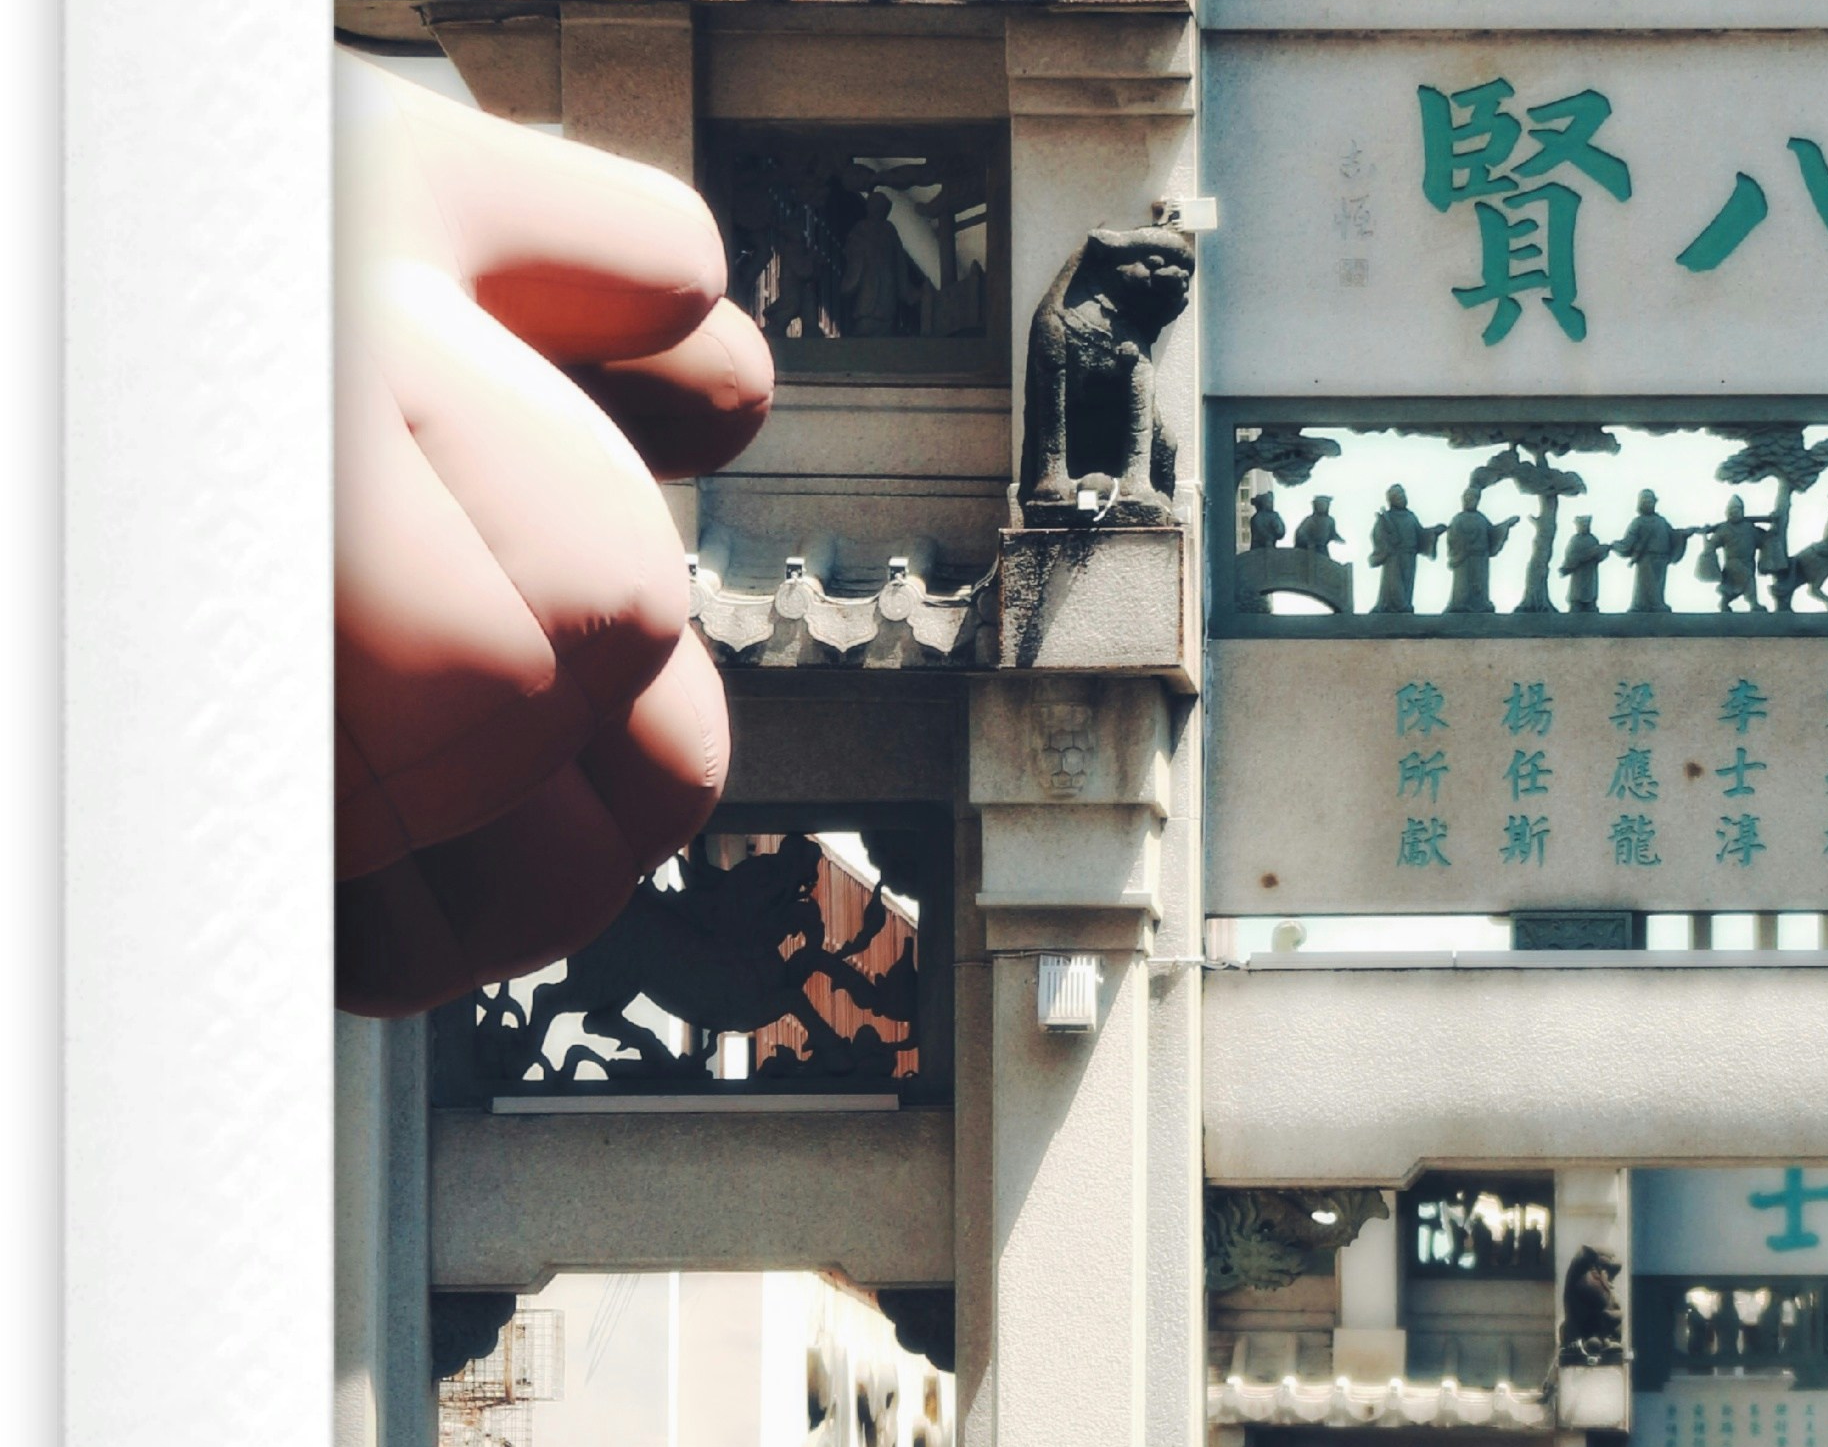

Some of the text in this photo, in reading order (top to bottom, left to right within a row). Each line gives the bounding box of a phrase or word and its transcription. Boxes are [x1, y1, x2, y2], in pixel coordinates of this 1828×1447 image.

[1499, 680, 1556, 870] 楊任斯
[1605, 680, 1663, 868] 梁應龍
[1715, 678, 1769, 868] 李士淳
